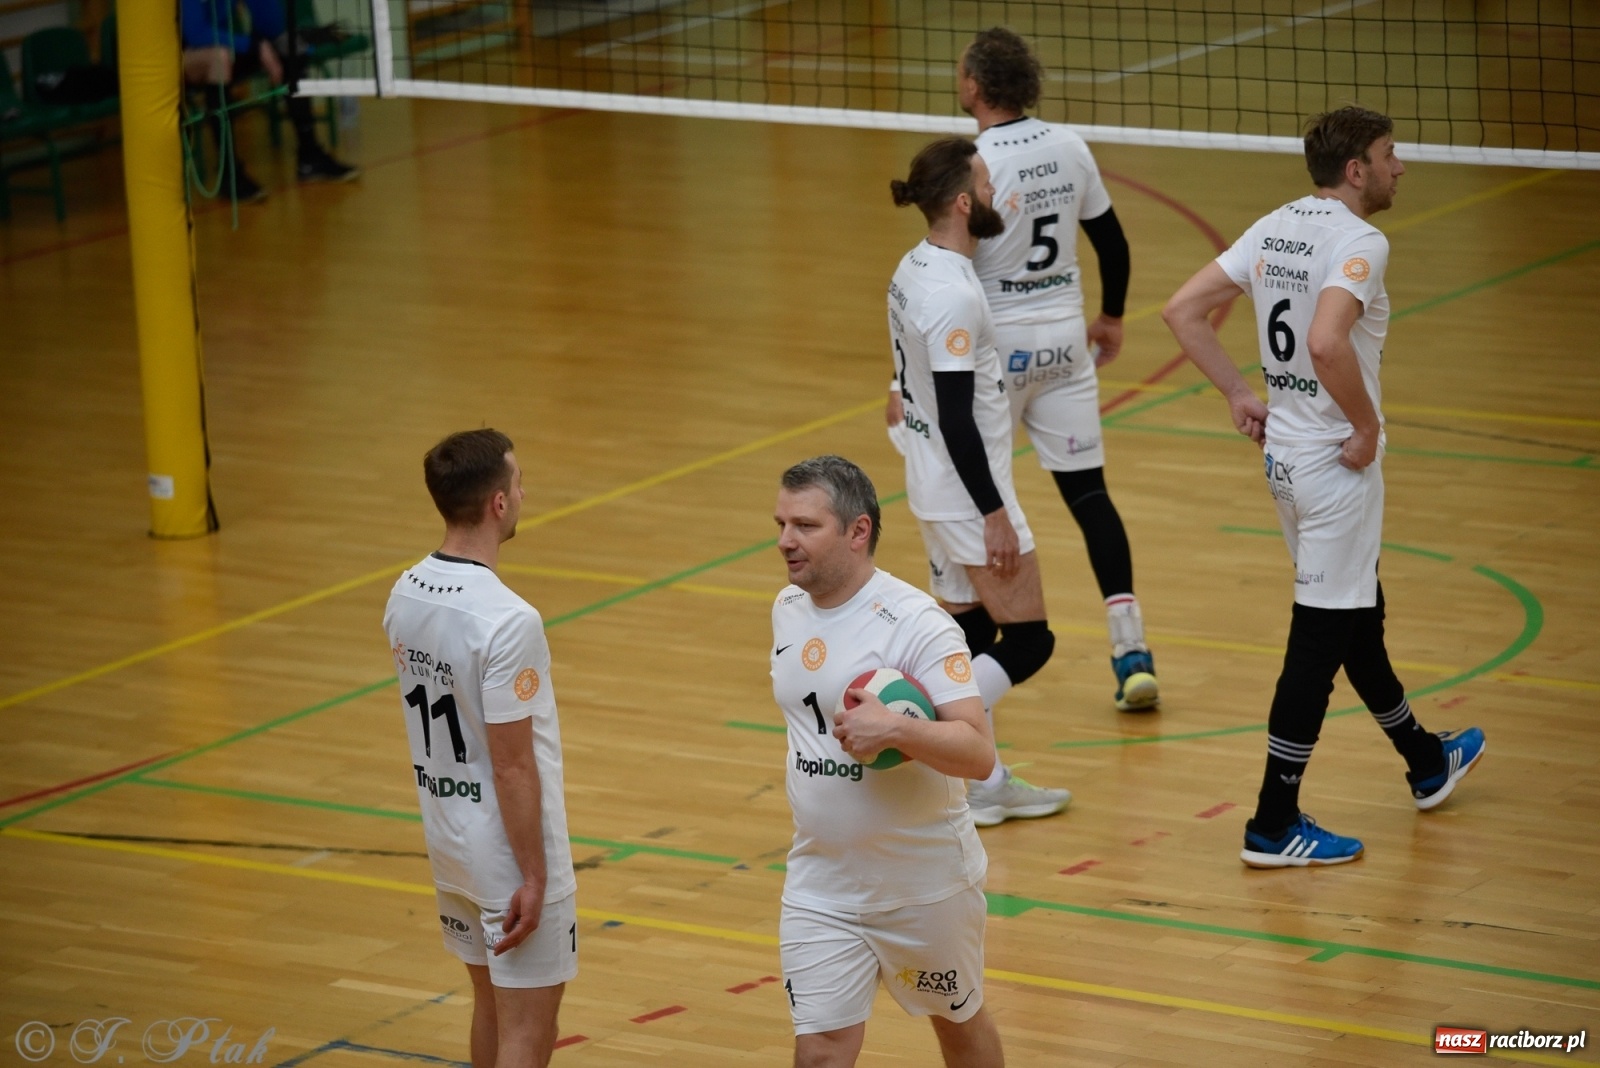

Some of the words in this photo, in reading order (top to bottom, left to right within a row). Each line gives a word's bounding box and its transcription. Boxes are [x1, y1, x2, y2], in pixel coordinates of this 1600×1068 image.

[1018, 161, 1058, 183] PYCIU
[1026, 213, 1059, 271] 5
[1261, 237, 1314, 257] SKORUPA
[1265, 278, 1309, 294] LUNATYCY
[1267, 298, 1296, 362] 6
[1036, 344, 1074, 368] DK
[1013, 365, 1074, 392] glass
[1261, 367, 1318, 397] TropiDog
[404, 683, 467, 764] 11
[802, 691, 827, 735] 1
[795, 750, 864, 782] TropiDog
[916, 979, 959, 992] MAR
[917, 969, 958, 982] ZOO
